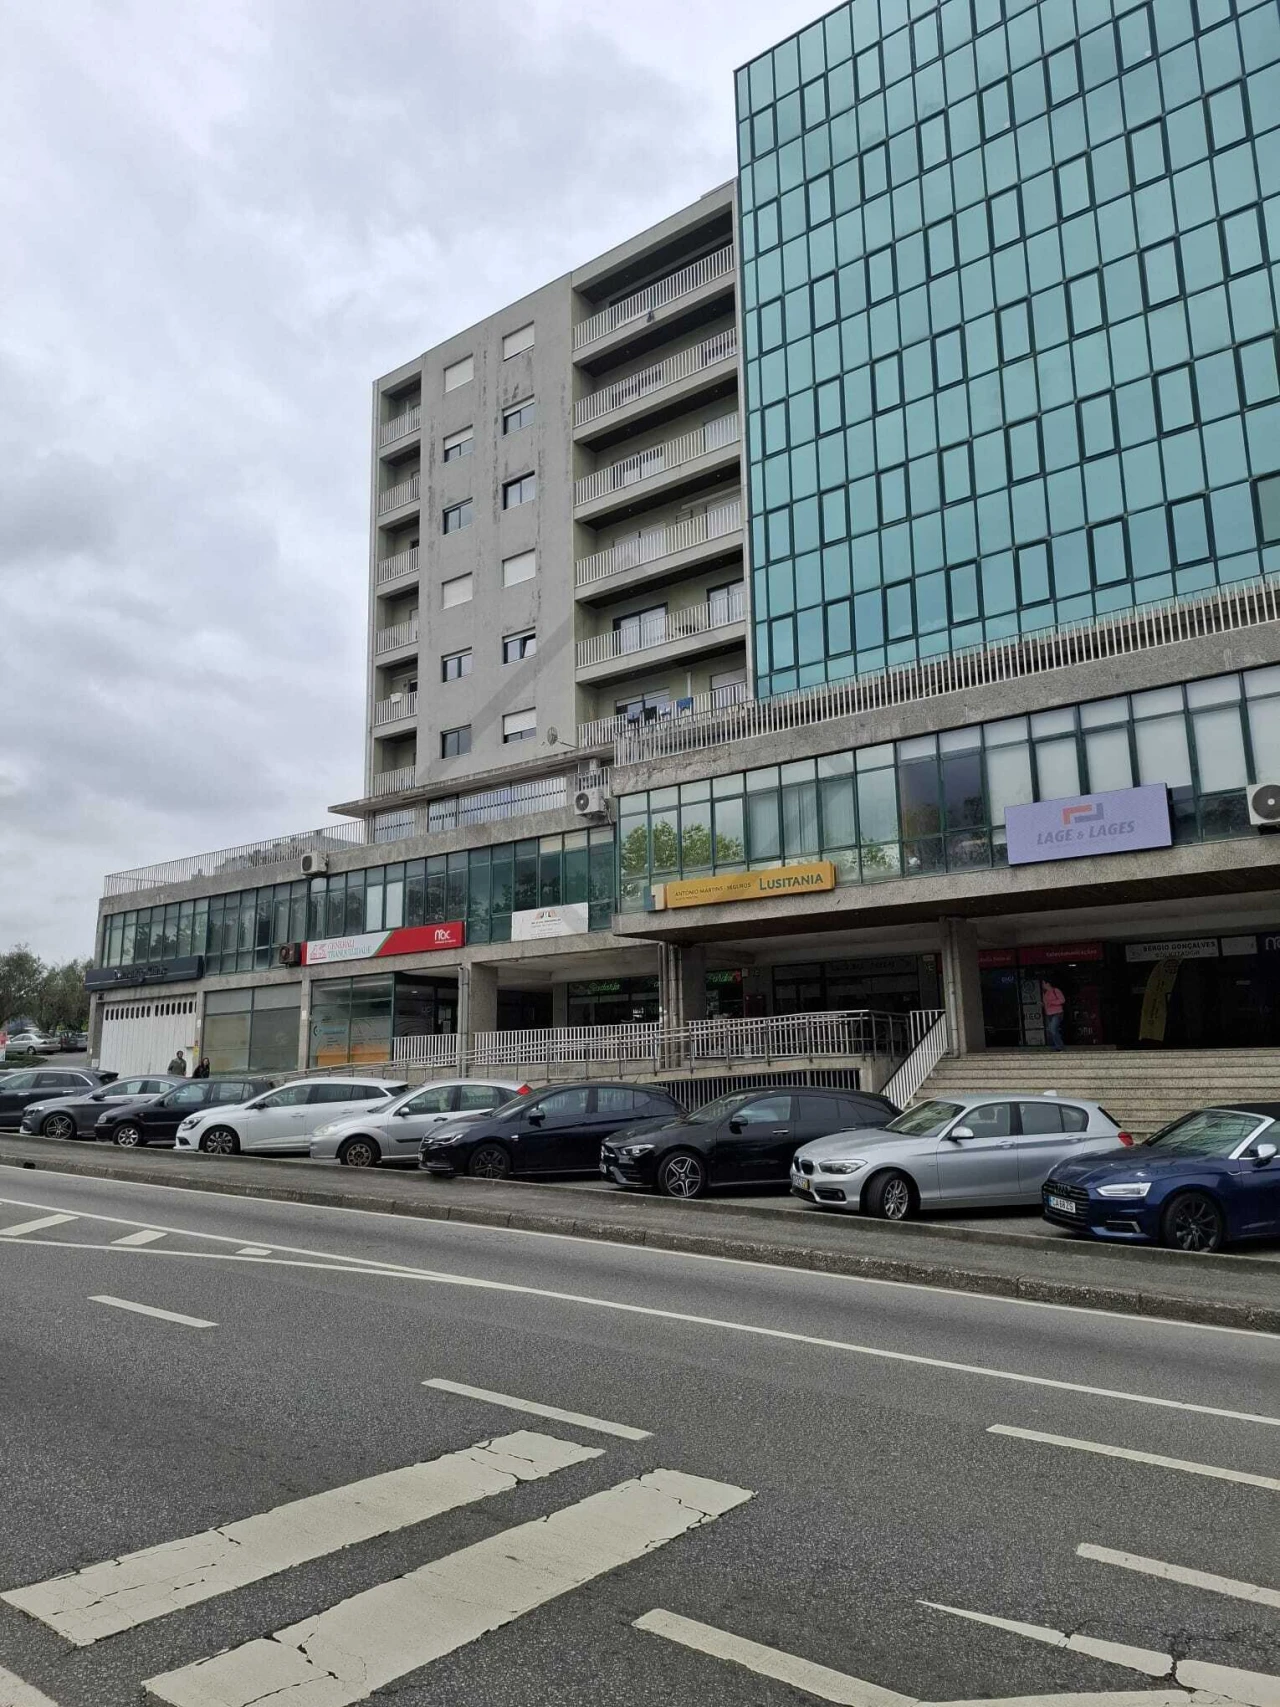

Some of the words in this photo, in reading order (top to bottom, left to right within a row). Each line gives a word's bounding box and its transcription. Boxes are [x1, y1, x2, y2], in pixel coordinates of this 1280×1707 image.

[1037, 828, 1073, 845] LAGE
[1076, 830, 1084, 840] &
[1089, 820, 1136, 839] LAGES
[1171, 941, 1216, 951] GONÇALVES
